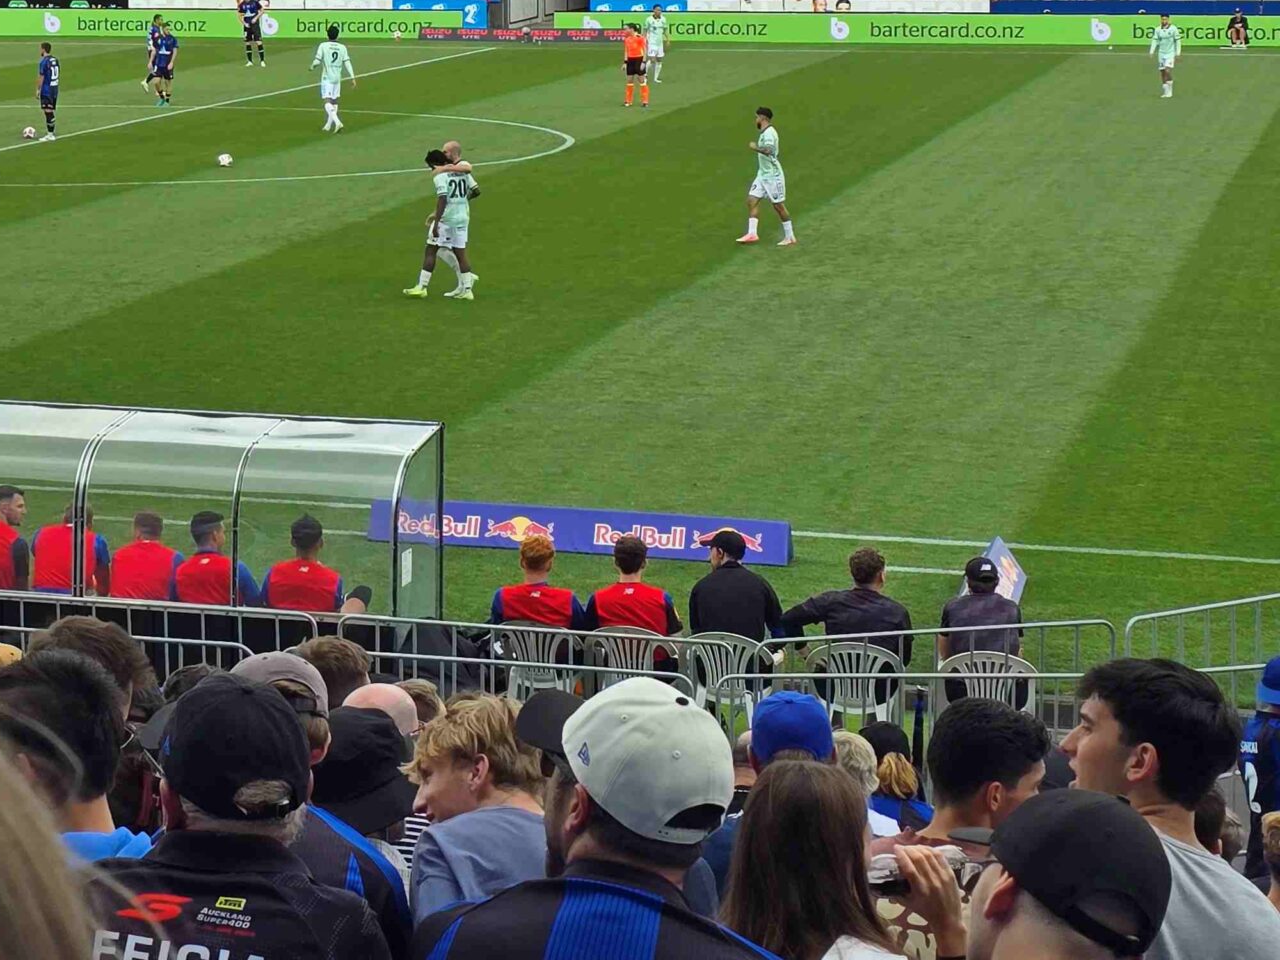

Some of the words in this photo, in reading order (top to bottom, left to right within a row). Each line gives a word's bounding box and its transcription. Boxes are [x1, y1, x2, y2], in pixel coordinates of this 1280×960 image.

[870, 20, 1025, 40] bartercard.co.nz
[331, 51, 339, 64] 9
[449, 178, 467, 199] 20
[200, 907, 252, 922] AUCKLAND
